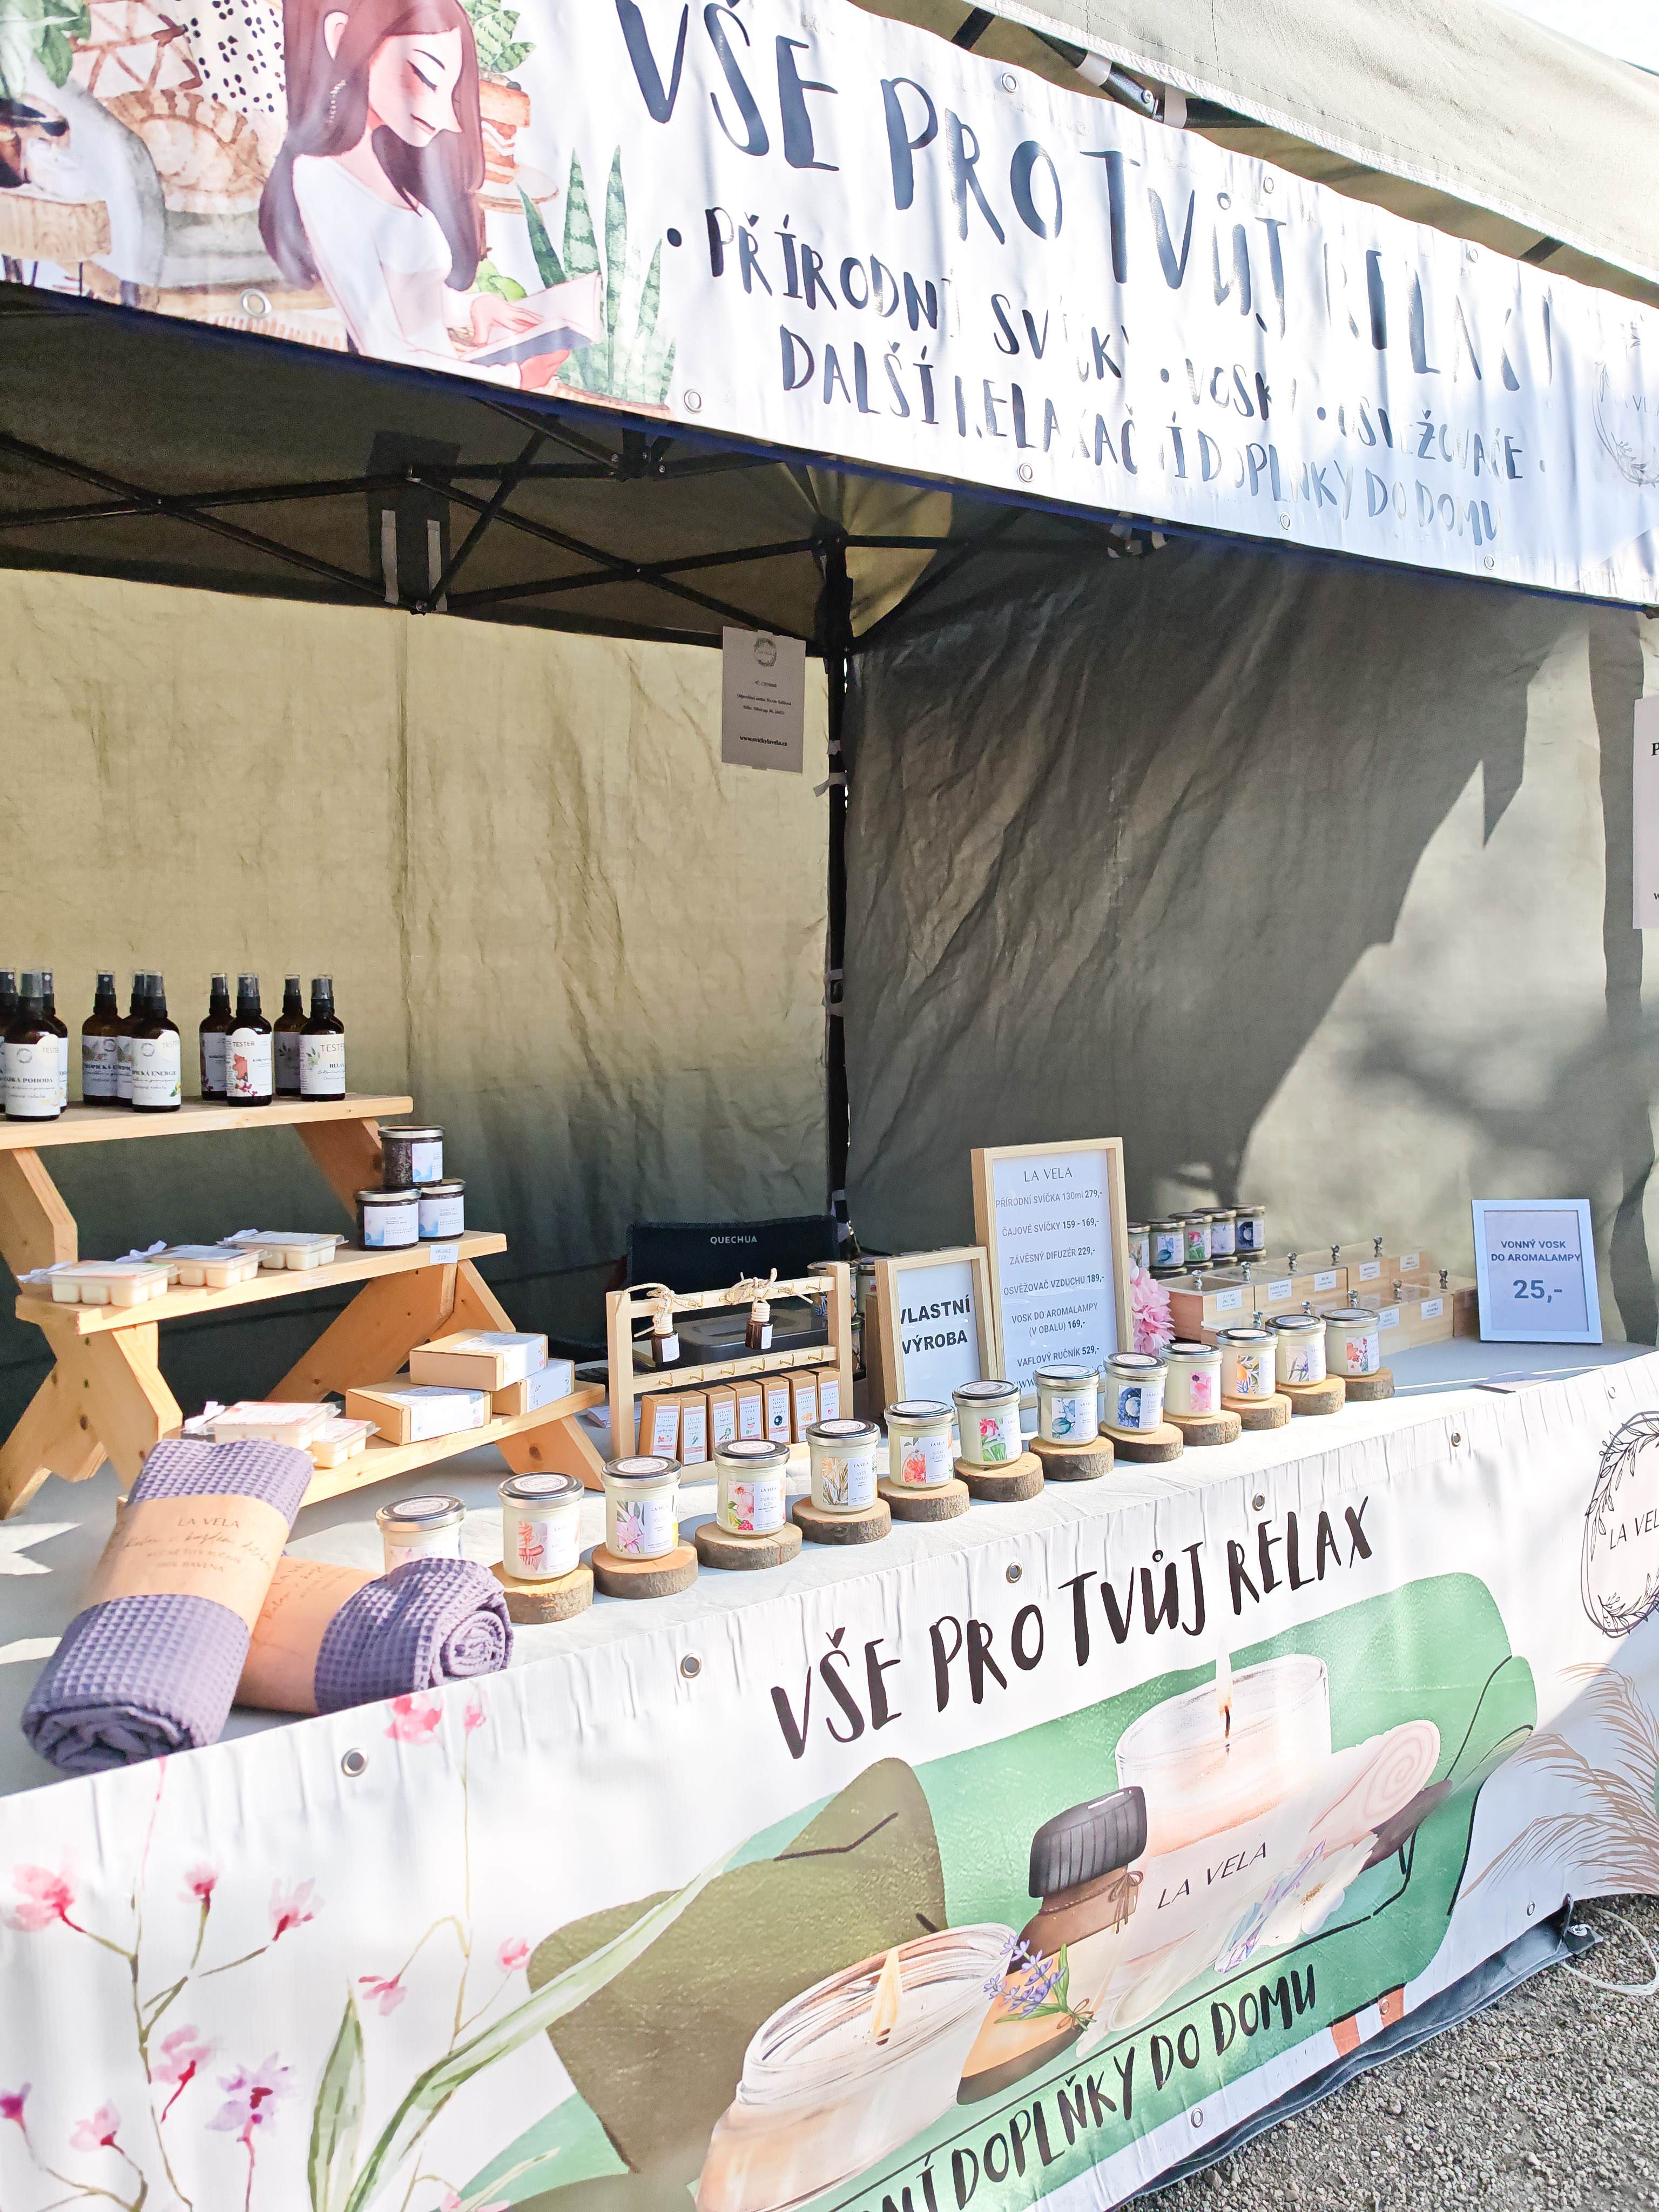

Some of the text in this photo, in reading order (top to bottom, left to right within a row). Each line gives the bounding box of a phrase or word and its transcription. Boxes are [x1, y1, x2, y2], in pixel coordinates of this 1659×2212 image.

[616, 0, 839, 171] VŠE
[880, 77, 1063, 245] PRO
[991, 294, 1131, 384] SVK
[1185, 358, 1298, 422] VOSK
[780, 325, 940, 424] DALŠÍ
[954, 375, 1189, 479] ELAAČÍ
[1365, 467, 1407, 522] DO
[1415, 478, 1505, 547] DOMU
[161, 1040, 180, 1048] TESTE
[320, 1043, 345, 1053] TESTE
[1024, 1166, 1073, 1182] LA VELA
[995, 1189, 1103, 1208] PŘÍRODNÍ SVÍČKA 130ml 279,-
[1002, 1223, 1033, 1237] ČAJOVÉ
[1034, 1221, 1061, 1233] SVÍČKY
[1062, 1220, 1075, 1229] 159
[1082, 1217, 1100, 1228] 169,-
[710, 1235, 758, 1245] QUECHUA
[1500, 1239, 1567, 1249] VONNÝ VOSK
[1009, 1246, 1096, 1265] ZÁVĚSNÝ DIFUZÉR 229,-
[1491, 1253, 1581, 1262] DO AROMALAMPY
[1003, 1273, 1105, 1296] OSVĚŽOVAČ VZDUCHU 189,-
[1513, 1279, 1563, 1304] 25,-
[900, 1294, 970, 1325] VLASTNÍ
[1011, 1302, 1098, 1324] VOSK DO AROMALAMPY
[1029, 1319, 1085, 1338] (V OBALU) 169,-
[902, 1330, 968, 1354] VÝROBA
[1017, 1345, 1100, 1367] VAFLOVÝ RUČNÍK 529,-
[178, 1518, 239, 1529] LA VELA
[1609, 1508, 1659, 1550] LA VEL
[770, 1495, 1373, 1759] VŠE PRO TVŮJ RELAX
[1157, 1842, 1266, 1910] LA VELA
[951, 2046, 1136, 2211] DOPLŇKY
[1151, 2024, 1200, 2092] DO
[1212, 1963, 1317, 2057] DOMU
